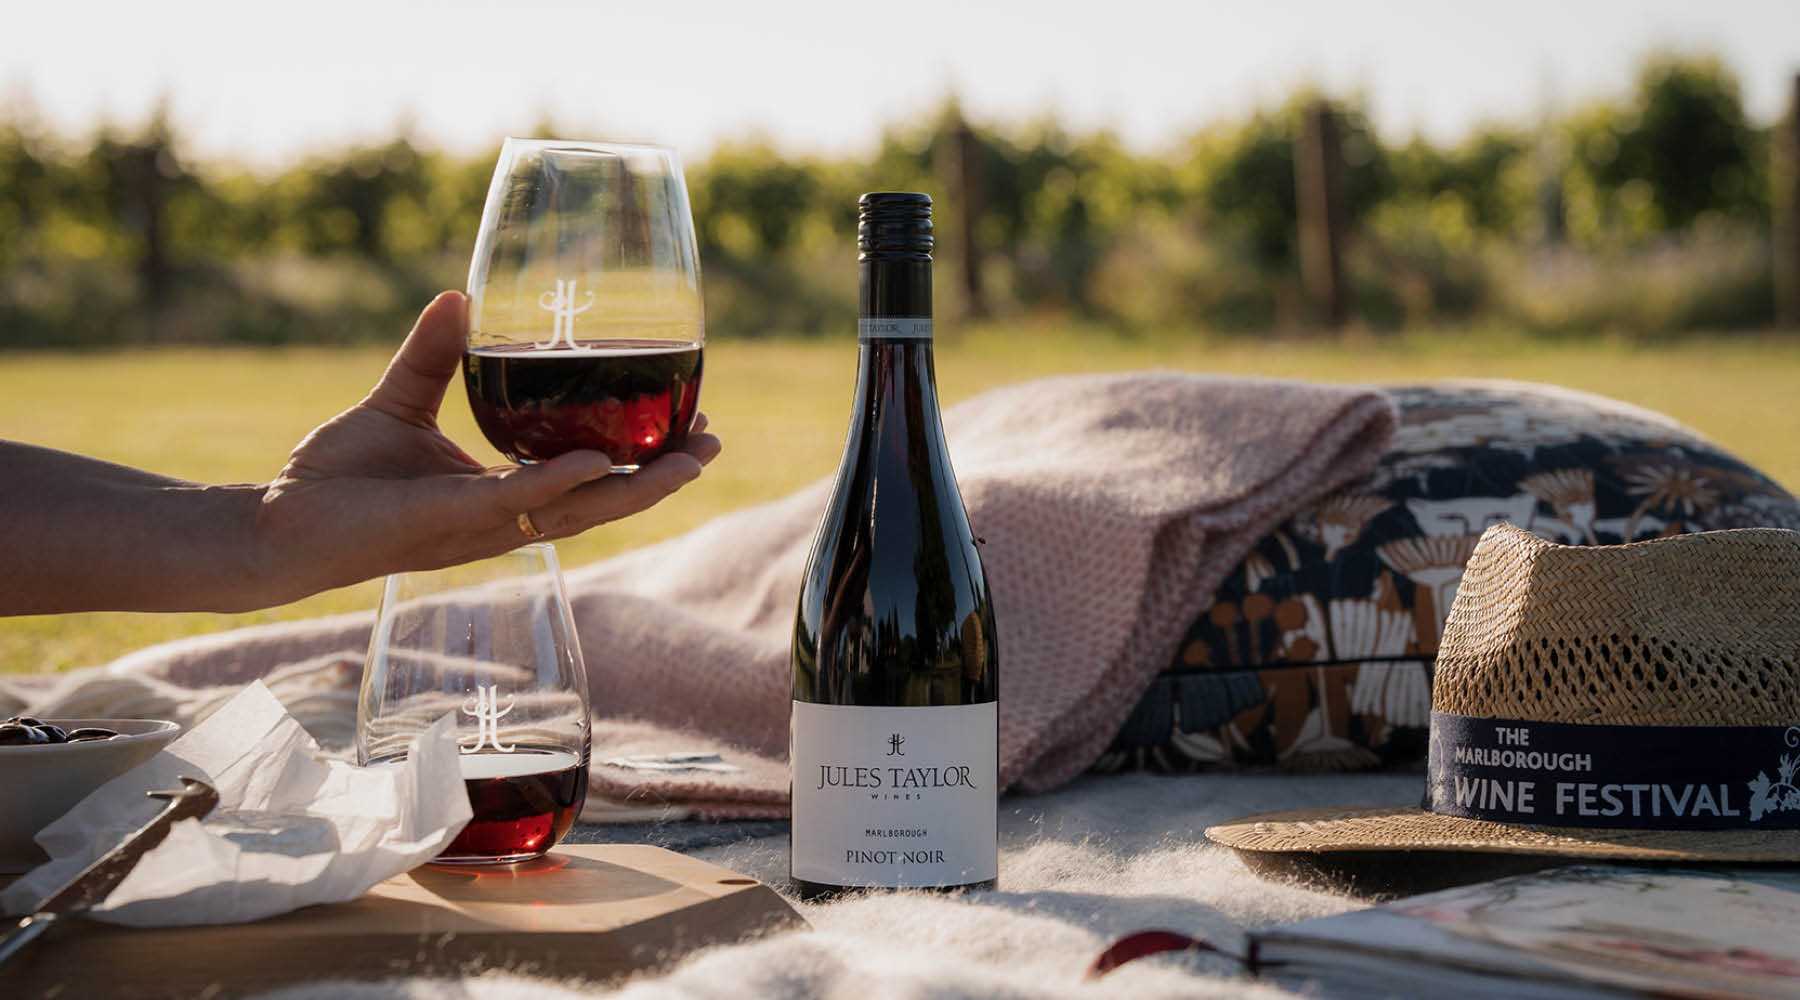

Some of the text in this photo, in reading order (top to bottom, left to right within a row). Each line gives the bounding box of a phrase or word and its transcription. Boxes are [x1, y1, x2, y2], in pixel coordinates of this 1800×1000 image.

[1495, 727, 1530, 747] THE
[1455, 746, 1592, 772] MARLBOROUGH
[817, 765, 977, 790] JULES TAYLOR
[871, 793, 921, 801] WINES
[1454, 775, 1740, 817] WINE FESTIVAL
[865, 828, 928, 839] MARLBOROUGH
[846, 850, 946, 865] PINOT NOIR
